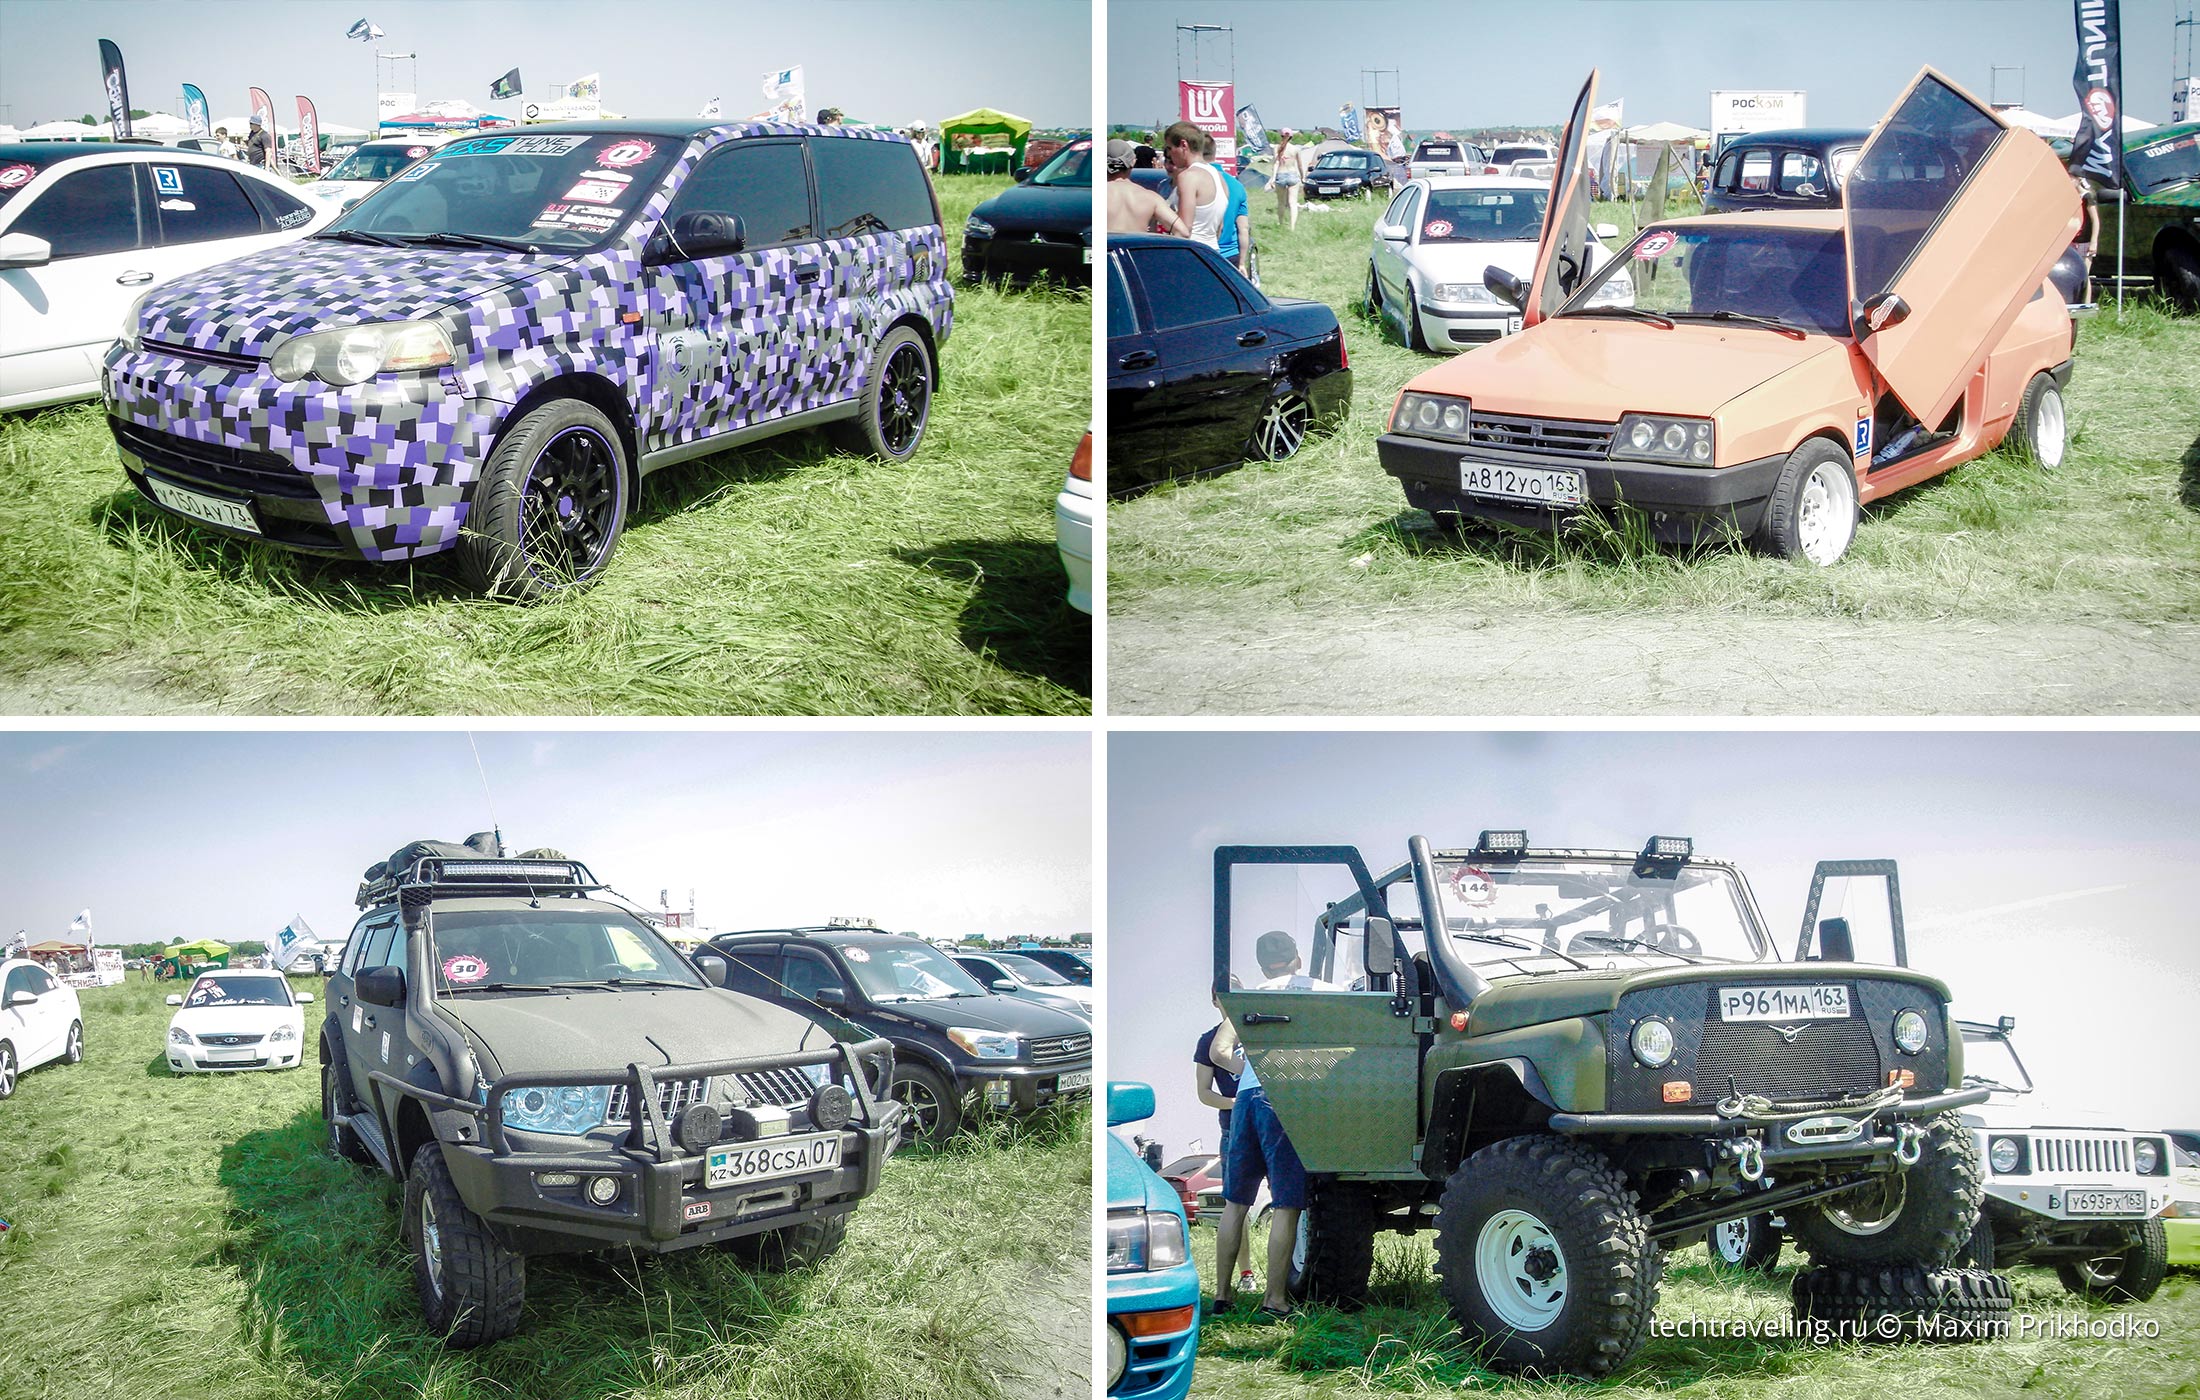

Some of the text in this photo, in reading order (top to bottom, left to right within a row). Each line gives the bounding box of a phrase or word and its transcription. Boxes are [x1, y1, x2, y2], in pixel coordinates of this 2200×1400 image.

[517, 137, 572, 146] TUNE
[514, 145, 572, 154] CLUB
[1643, 241, 1667, 250] 33
[1546, 474, 1574, 493] 163
[1552, 492, 1568, 500] RUS
[223, 503, 247, 522] 73
[1460, 883, 1489, 893] 144
[454, 964, 477, 974] 30
[1813, 988, 1843, 1006] 163
[730, 1138, 838, 1178] 368CSA 07
[710, 1168, 727, 1182] KZ
[688, 1203, 710, 1217] ARB
